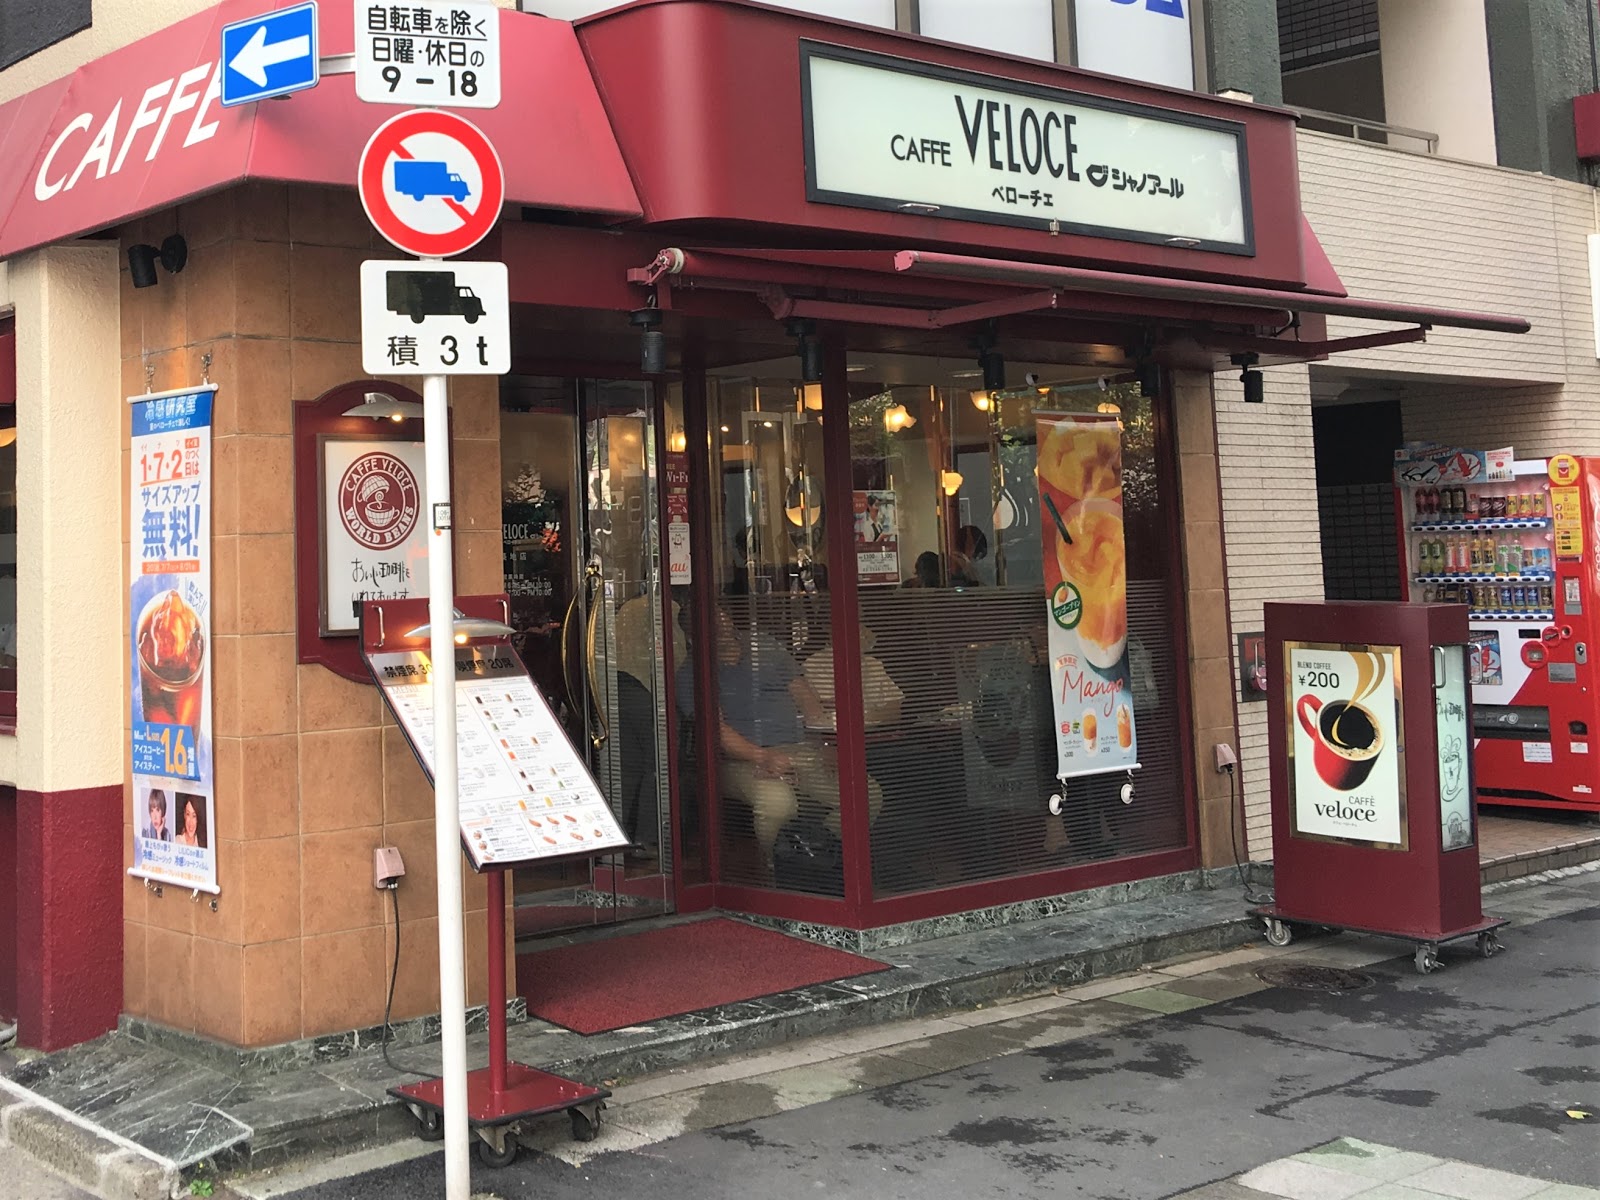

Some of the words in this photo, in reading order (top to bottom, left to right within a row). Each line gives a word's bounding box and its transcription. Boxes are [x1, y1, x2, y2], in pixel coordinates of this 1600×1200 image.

[368, 5, 486, 37] 自転車を除く
[373, 37, 485, 67] 日曜・休日の
[382, 66, 401, 92] 9
[448, 70, 478, 97] 18
[890, 134, 952, 167] CAFFE
[954, 95, 1080, 182] VELOCE
[992, 187, 1053, 207] ベローチェ
[1112, 168, 1184, 199] シャノアール
[387, 335, 419, 366] 積
[440, 335, 459, 366] 3
[476, 336, 488, 365] t
[346, 459, 378, 491] CAFFE
[382, 459, 412, 491] VELOCE
[142, 481, 201, 507] サイズアップ
[142, 504, 200, 558] 無料!
[345, 506, 380, 543] WORLD
[384, 506, 413, 543] BEANS
[502, 524, 529, 539] ELOCE
[671, 563, 686, 572] au
[384, 664, 418, 678] 禁煙席
[1297, 661, 1312, 669] BLEND
[1313, 662, 1331, 670] COFFEE
[1062, 670, 1123, 717] Mango
[1298, 672, 1340, 688] ¥200
[134, 744, 165, 756] アイスコーヒー
[134, 760, 160, 772] アイスティー
[1314, 801, 1378, 822] veloce
